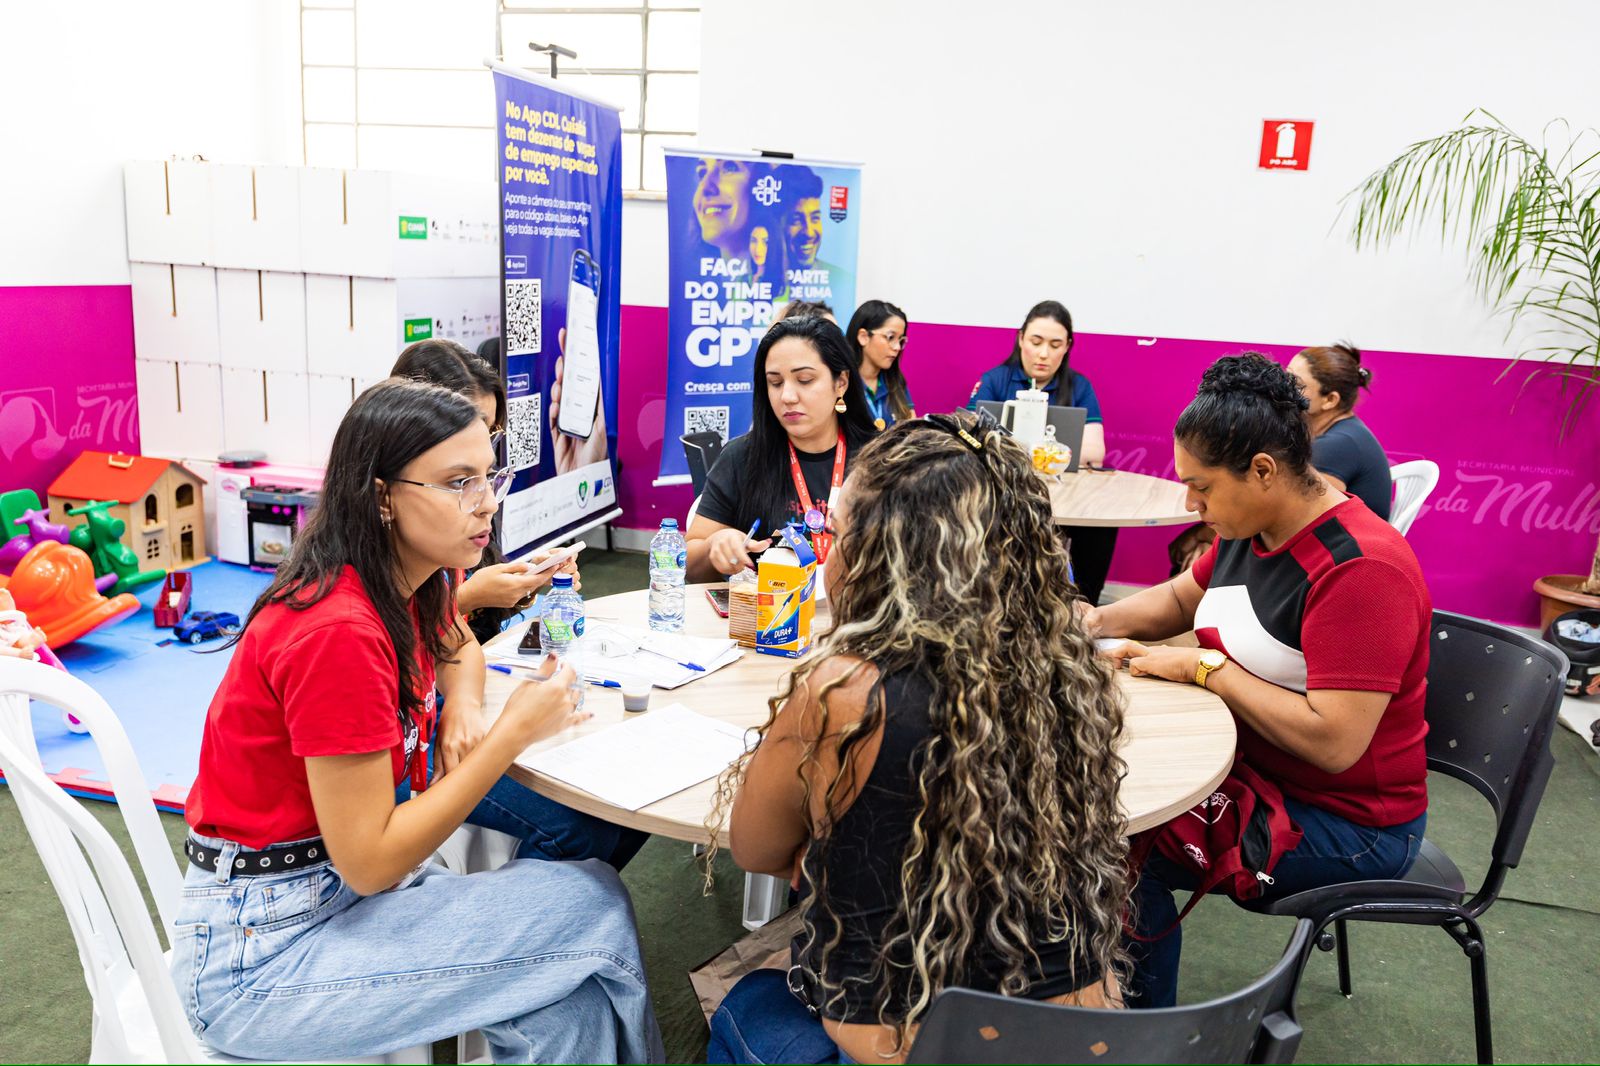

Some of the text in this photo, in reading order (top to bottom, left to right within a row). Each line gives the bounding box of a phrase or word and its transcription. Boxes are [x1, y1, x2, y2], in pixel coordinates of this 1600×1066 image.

[505, 100, 521, 121] No
[522, 105, 541, 129] App
[543, 110, 561, 130] CDL
[505, 122, 527, 142] tem
[528, 127, 563, 149] dezenas
[563, 133, 575, 153] de
[505, 141, 519, 161] de
[521, 148, 561, 171] emprego
[505, 166, 523, 184] por
[684, 281, 719, 300] DO
[722, 282, 772, 300] TIME
[804, 285, 832, 299] UMA
[684, 381, 751, 394] Cresça com
[69, 409, 92, 440] da
[1457, 460, 1576, 477] SECRETARIA MUNICIPAL
[1434, 483, 1470, 513] da
